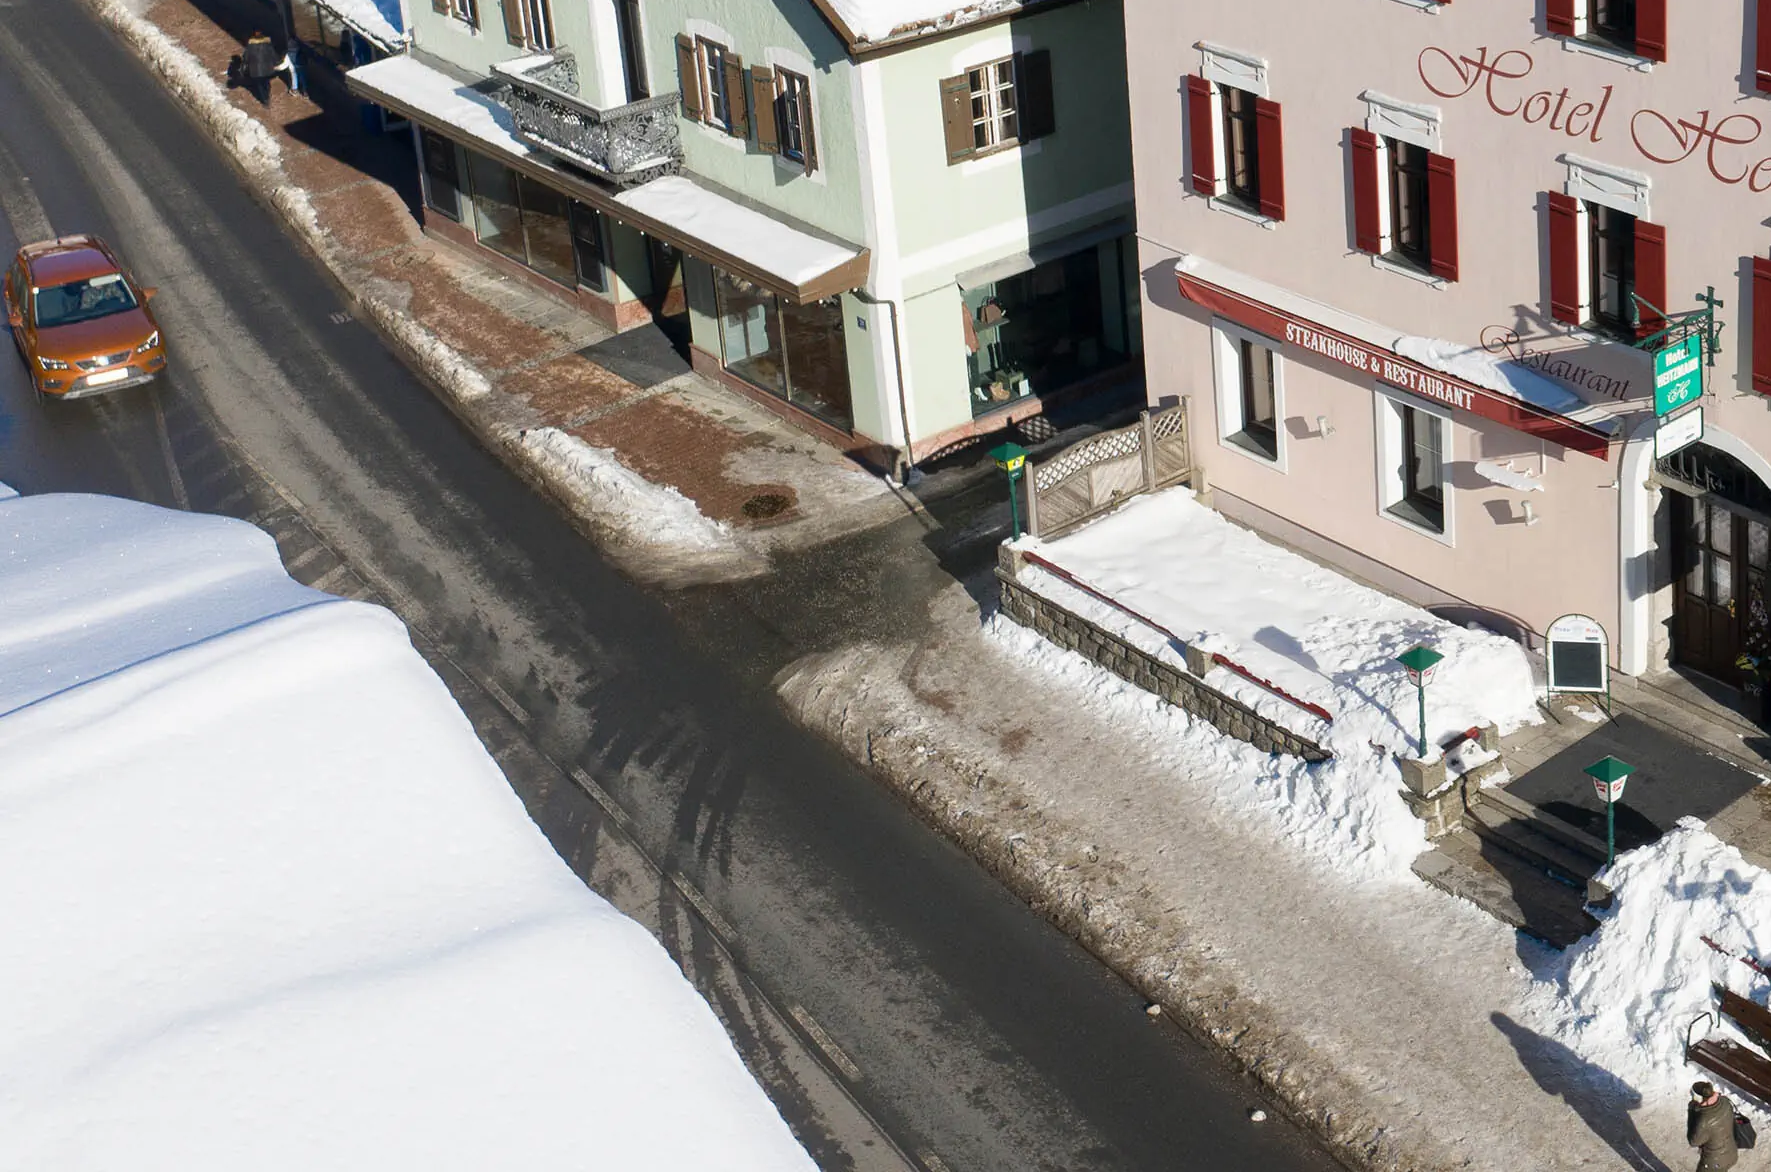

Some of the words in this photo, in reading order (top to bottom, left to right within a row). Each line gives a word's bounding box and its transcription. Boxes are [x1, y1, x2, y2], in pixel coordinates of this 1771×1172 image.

[1418, 46, 1613, 143] Hotel
[1286, 323, 1368, 370] STEAKHOUSE
[1370, 356, 1380, 373] &
[1384, 360, 1475, 410] RESTAURANT
[1480, 325, 1629, 400] Restaurant
